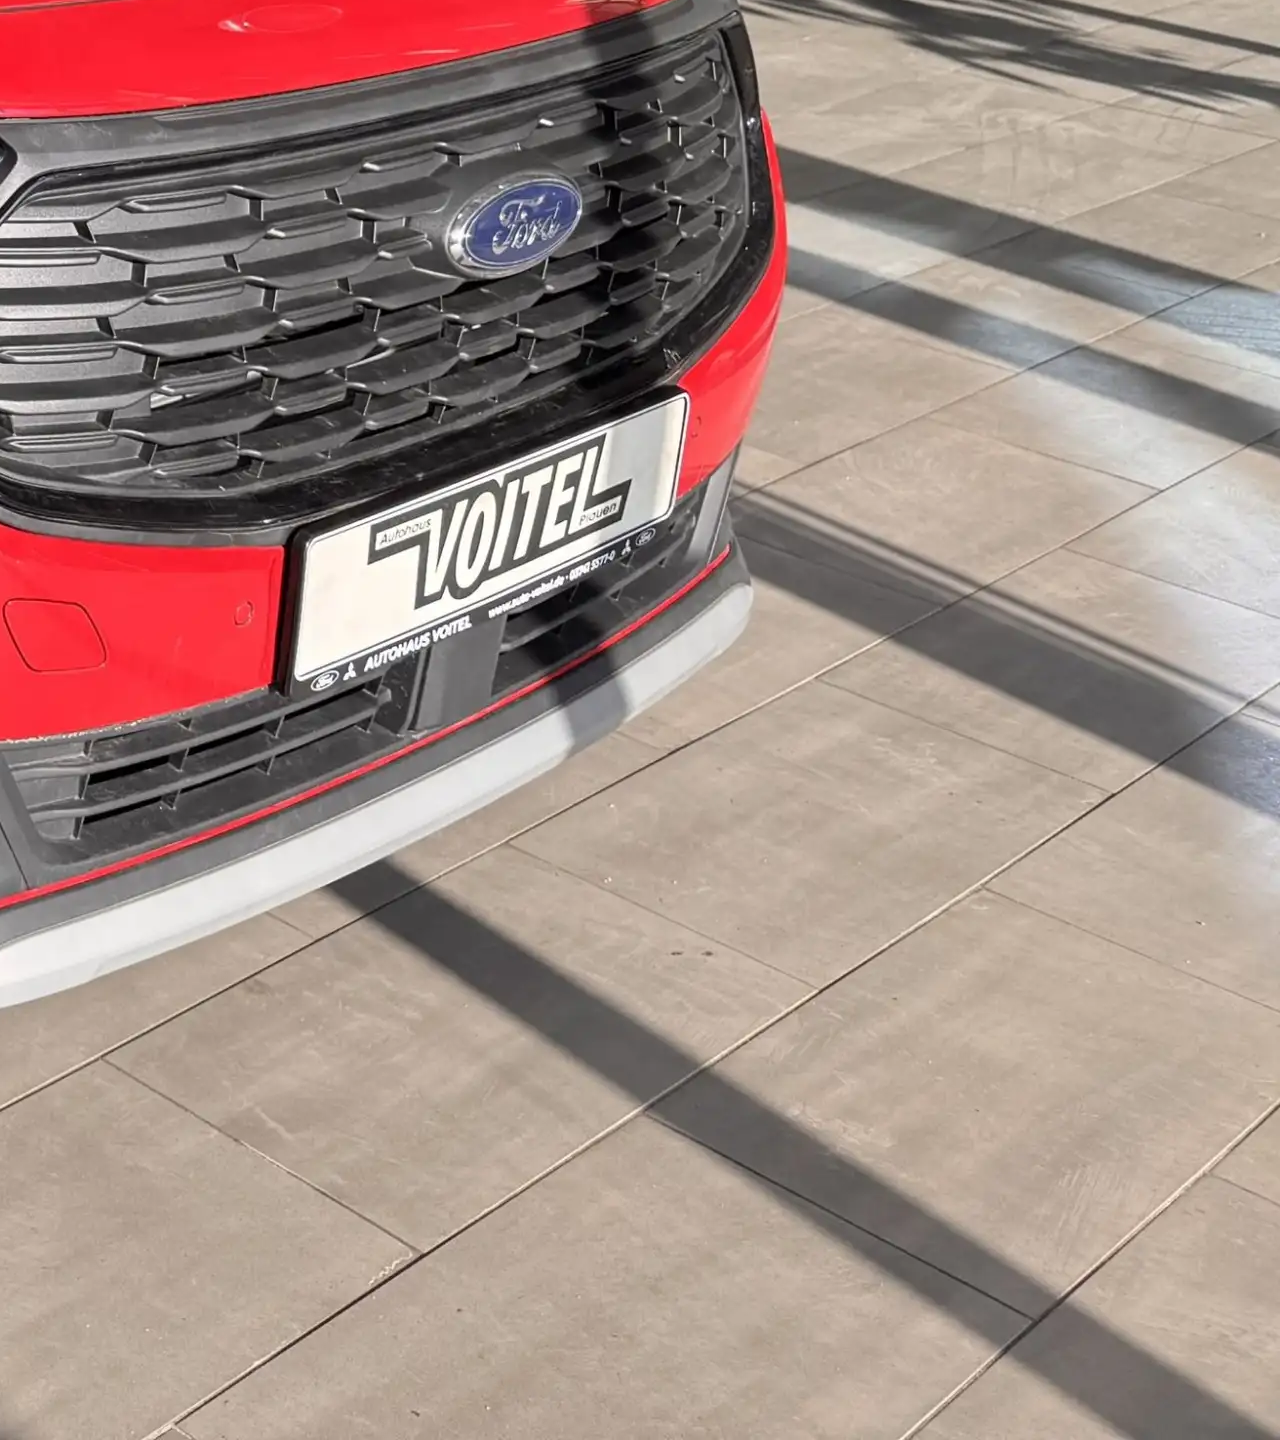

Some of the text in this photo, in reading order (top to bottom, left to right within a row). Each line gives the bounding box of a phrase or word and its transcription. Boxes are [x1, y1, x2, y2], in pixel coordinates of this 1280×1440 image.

[490, 190, 565, 257] Ford
[378, 517, 432, 546] Autohaus
[423, 444, 603, 598] VOITEL
[578, 502, 617, 526] Plauen
[363, 631, 431, 673] AUTOHAUS
[431, 614, 473, 643] VOITEL
[488, 573, 566, 619] www.auto-voitel.de
